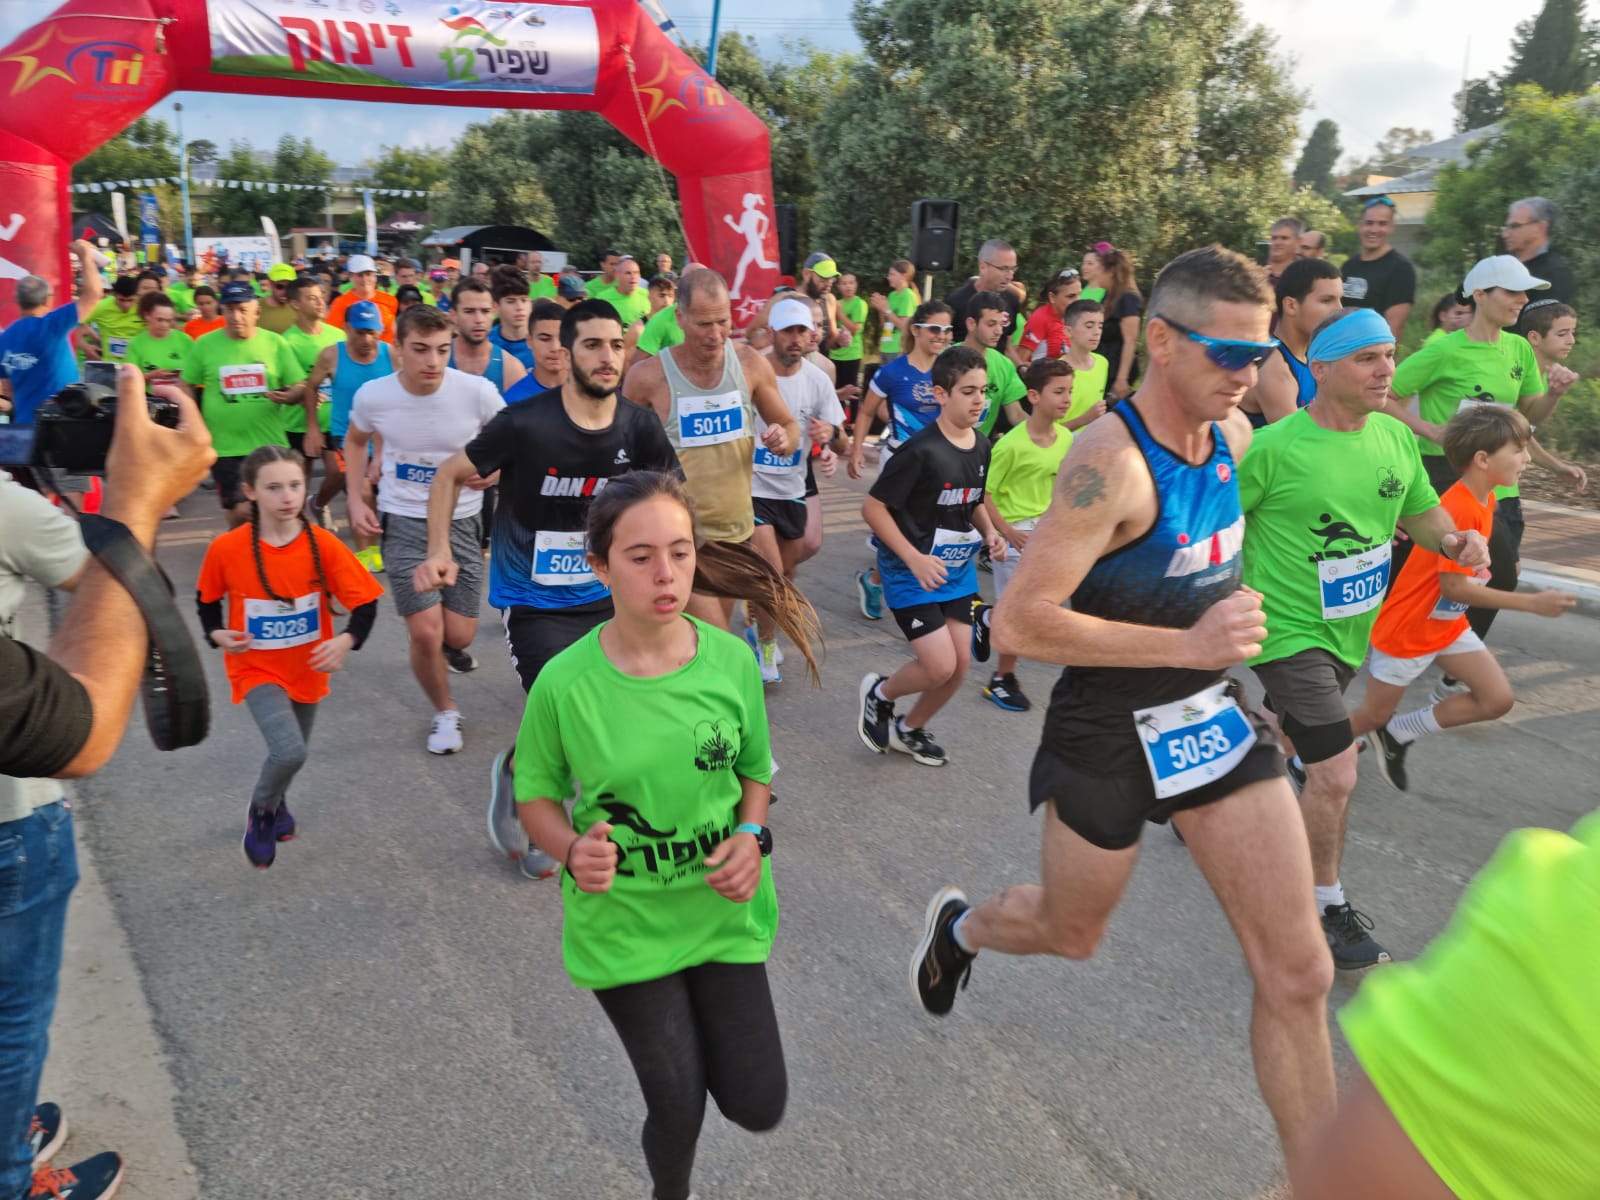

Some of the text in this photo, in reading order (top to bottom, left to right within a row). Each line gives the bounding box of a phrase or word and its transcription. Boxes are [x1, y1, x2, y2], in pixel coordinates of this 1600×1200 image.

[279, 16, 415, 72] זינוק
[694, 414, 731, 435] 5011
[941, 547, 973, 560] 5054
[1342, 571, 1383, 602] 5078
[261, 617, 308, 638] 5028
[1168, 724, 1231, 770] 5058
